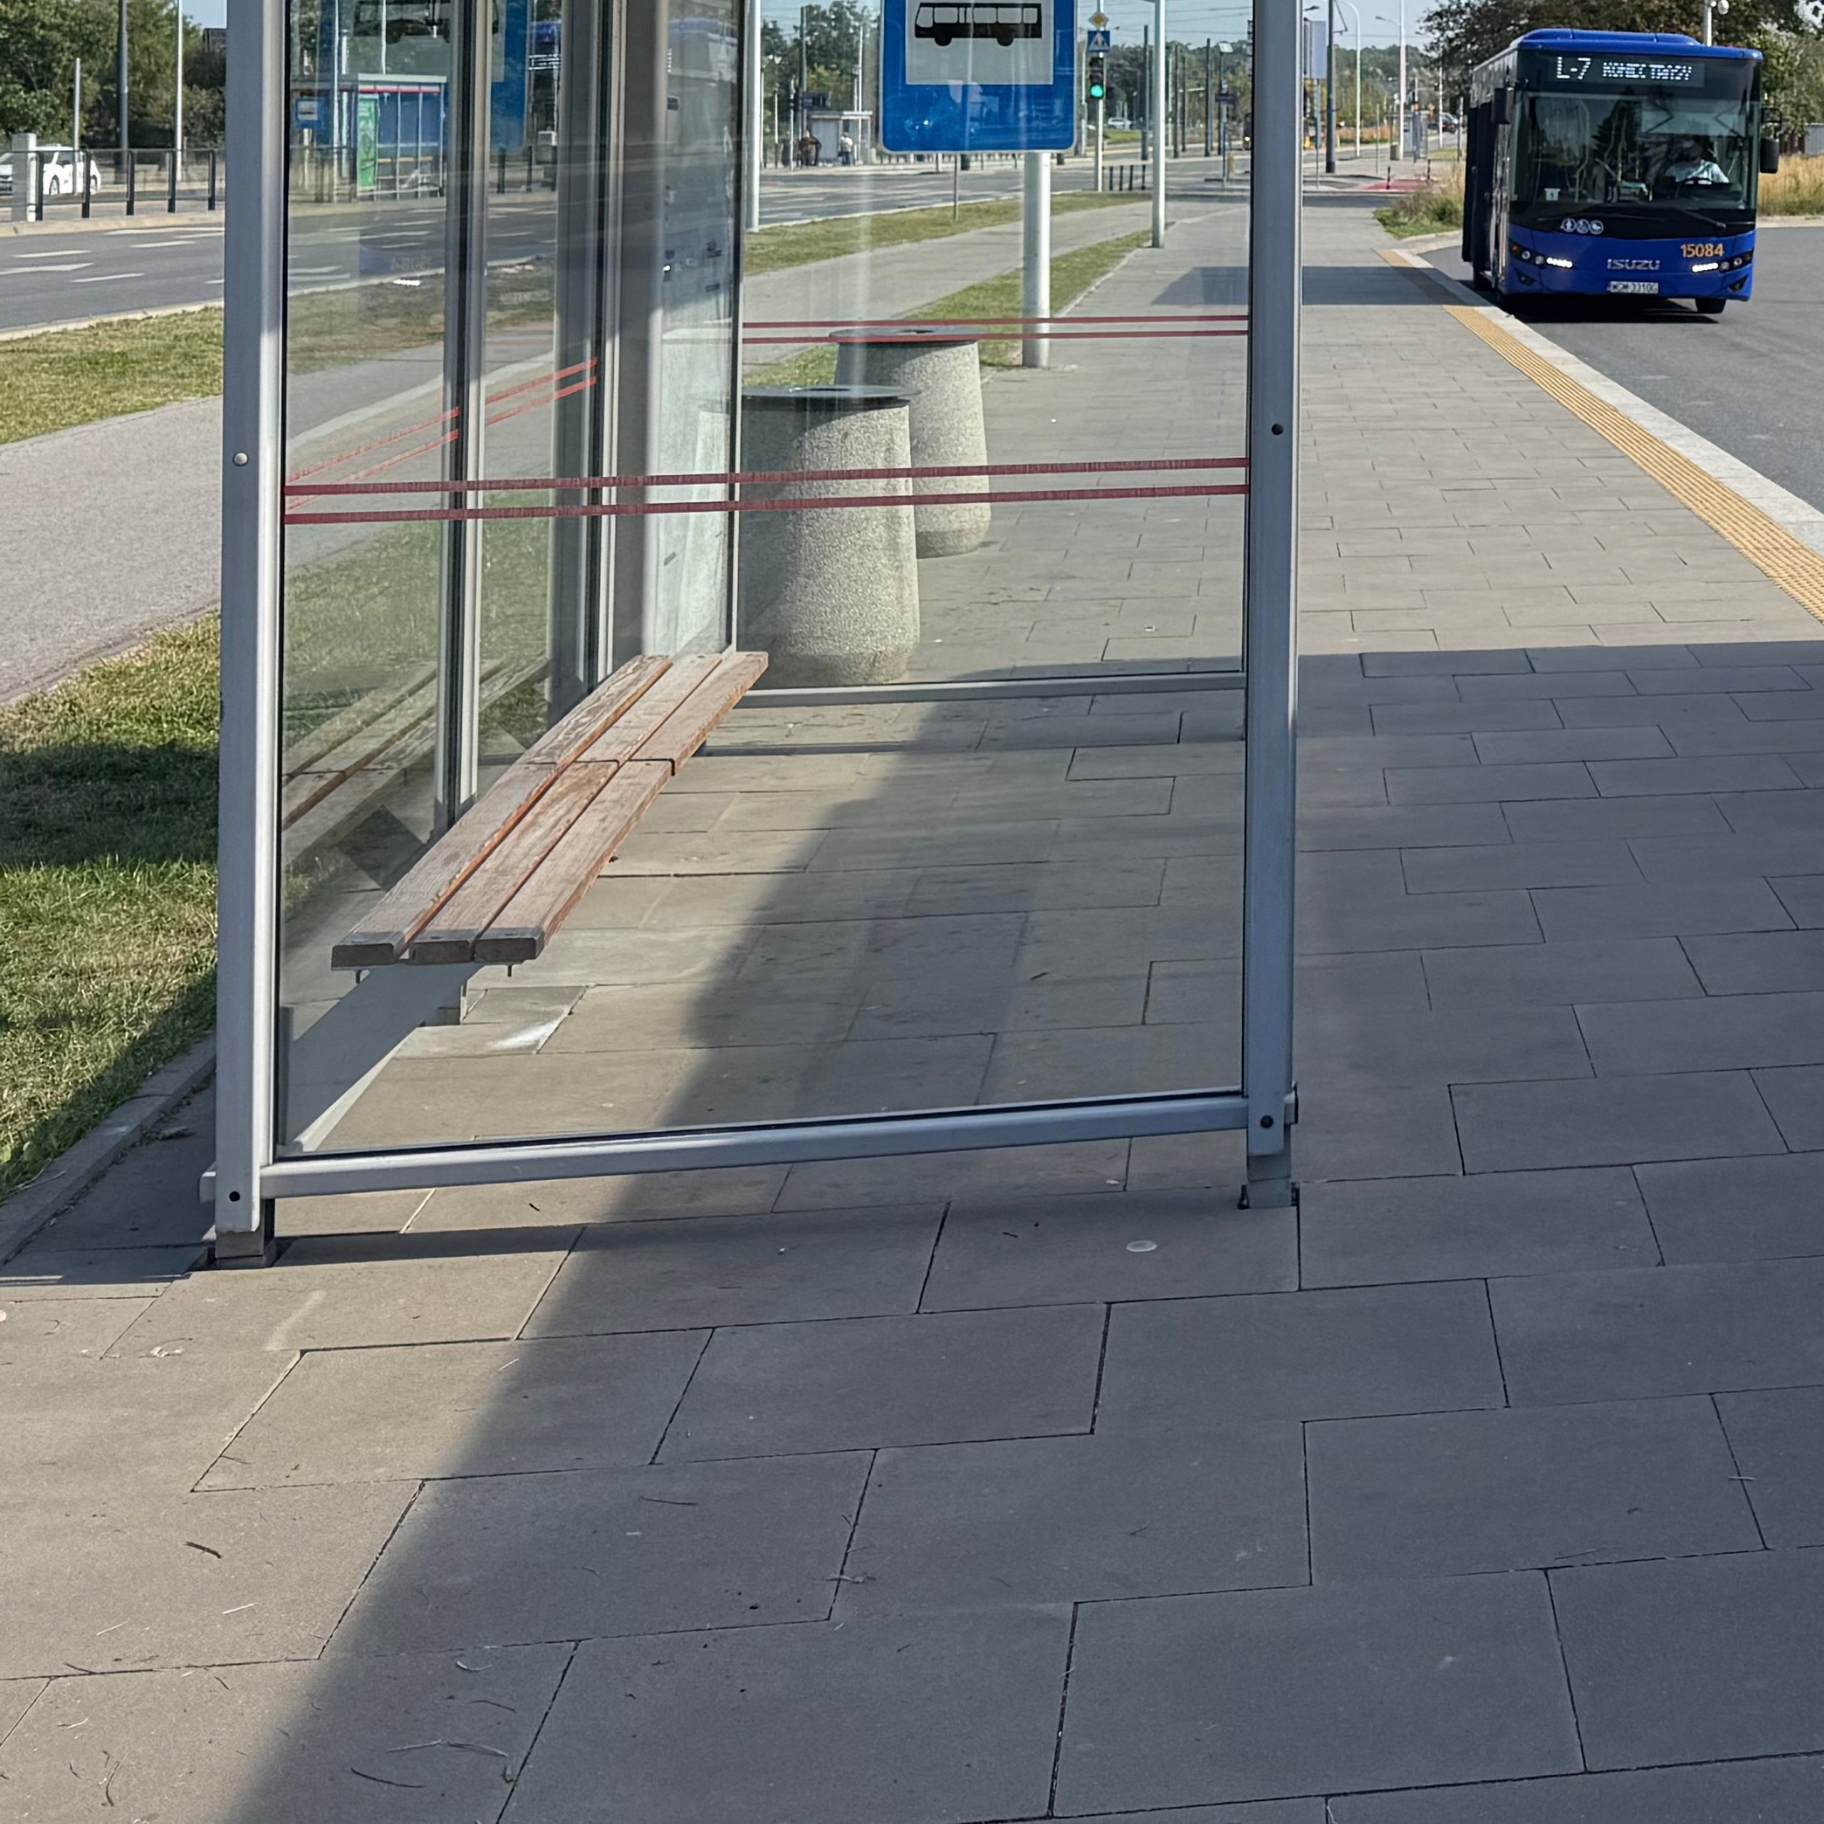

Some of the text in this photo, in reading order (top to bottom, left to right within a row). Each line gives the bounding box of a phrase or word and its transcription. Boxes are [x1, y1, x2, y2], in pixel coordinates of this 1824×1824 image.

[1556, 56, 1591, 80] L-7
[1680, 243, 1724, 258] 15084
[1607, 258, 1660, 270] ISUZU
